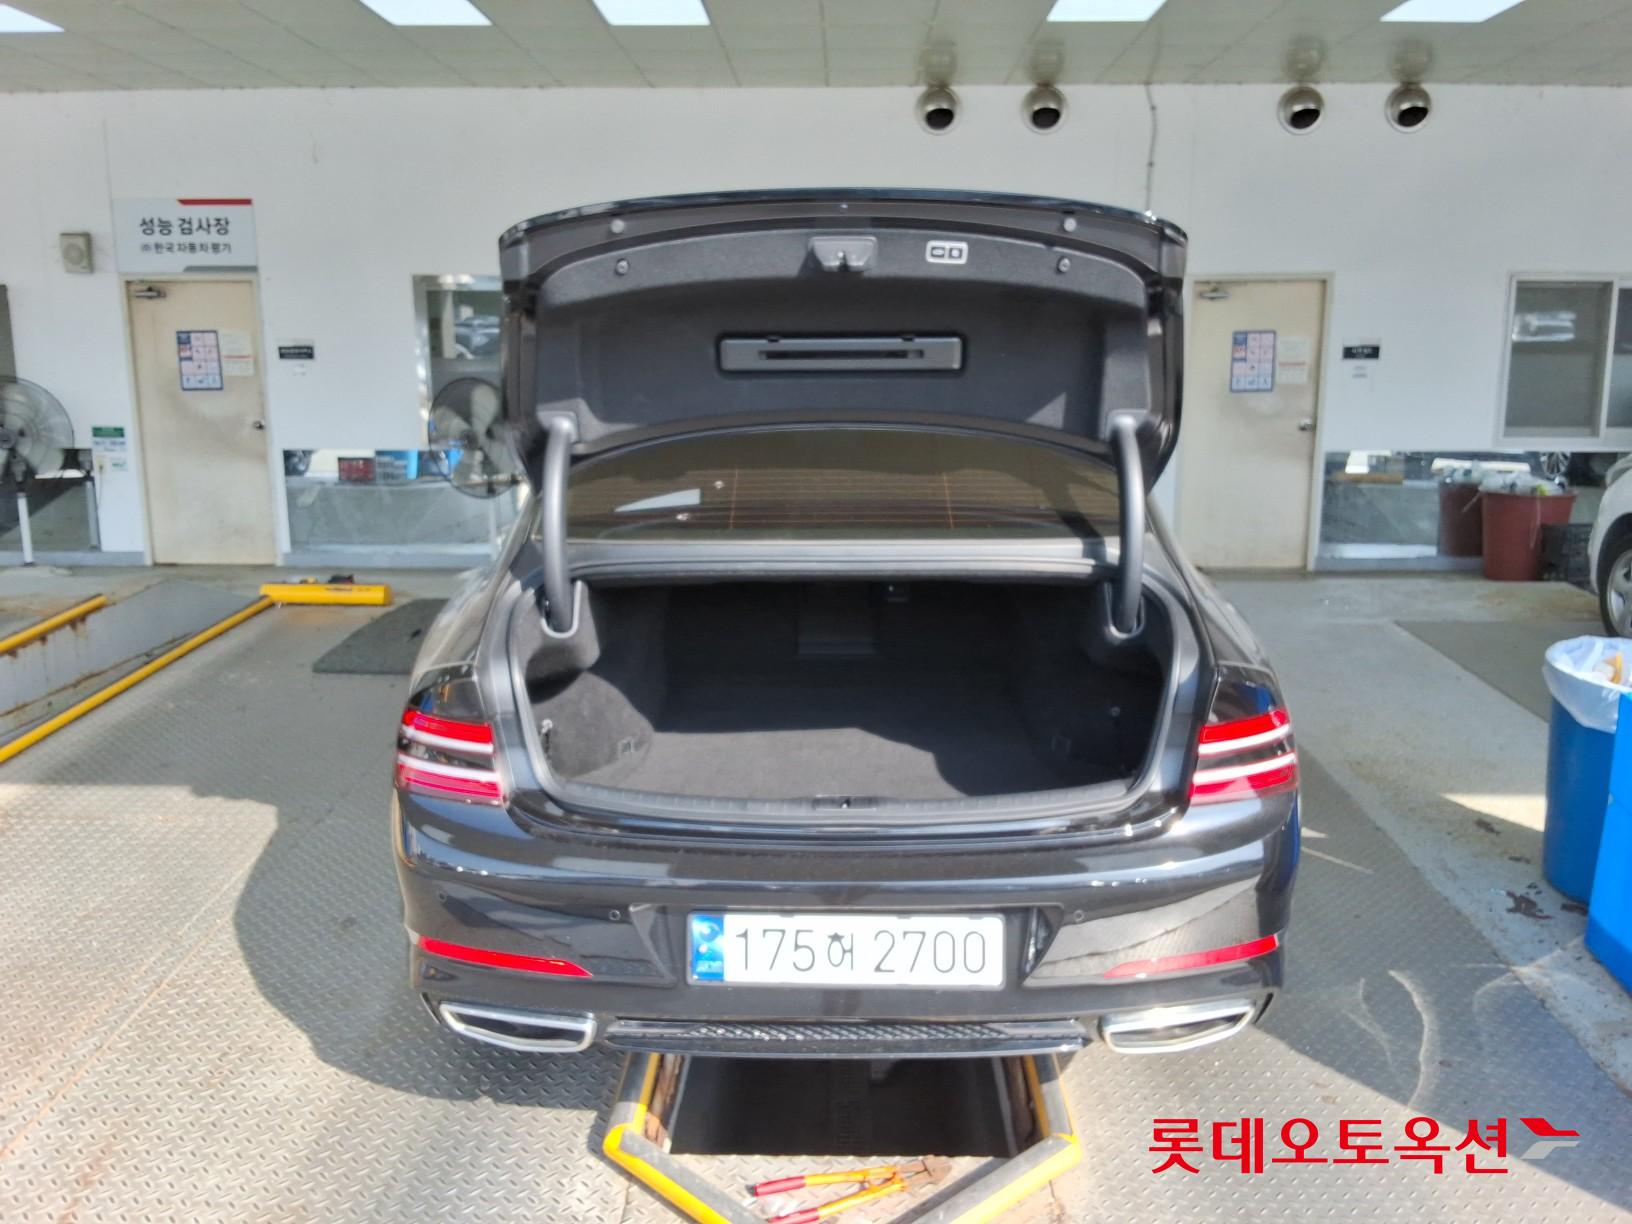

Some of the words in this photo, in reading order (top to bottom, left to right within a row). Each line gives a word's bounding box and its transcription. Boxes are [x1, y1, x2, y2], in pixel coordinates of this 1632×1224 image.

[140, 217, 173, 236] 성능
[178, 217, 230, 236] 검사장
[873, 929, 986, 973] 2700
